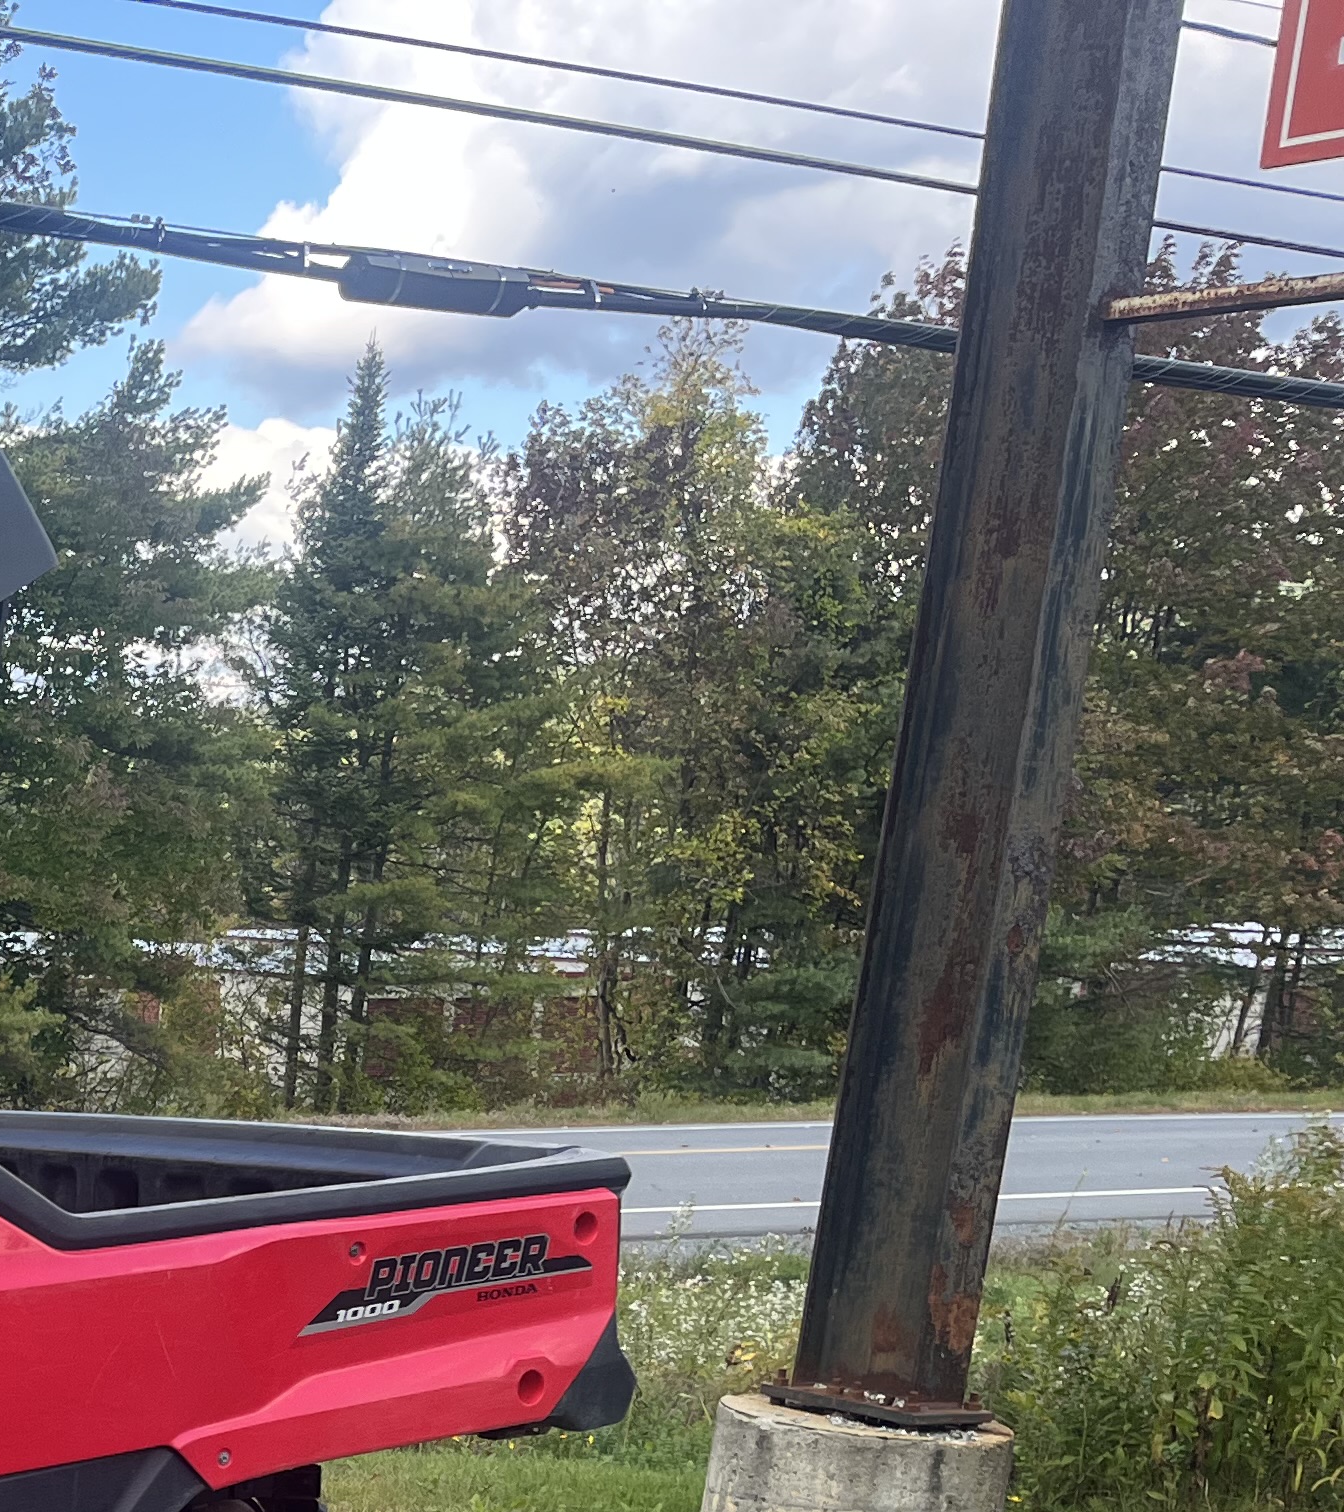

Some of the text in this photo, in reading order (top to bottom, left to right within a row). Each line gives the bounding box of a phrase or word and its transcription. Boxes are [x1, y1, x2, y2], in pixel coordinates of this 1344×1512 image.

[364, 1232, 550, 1301] PIONEER
[476, 1283, 538, 1302] HONDA
[336, 1299, 401, 1323] 1000
